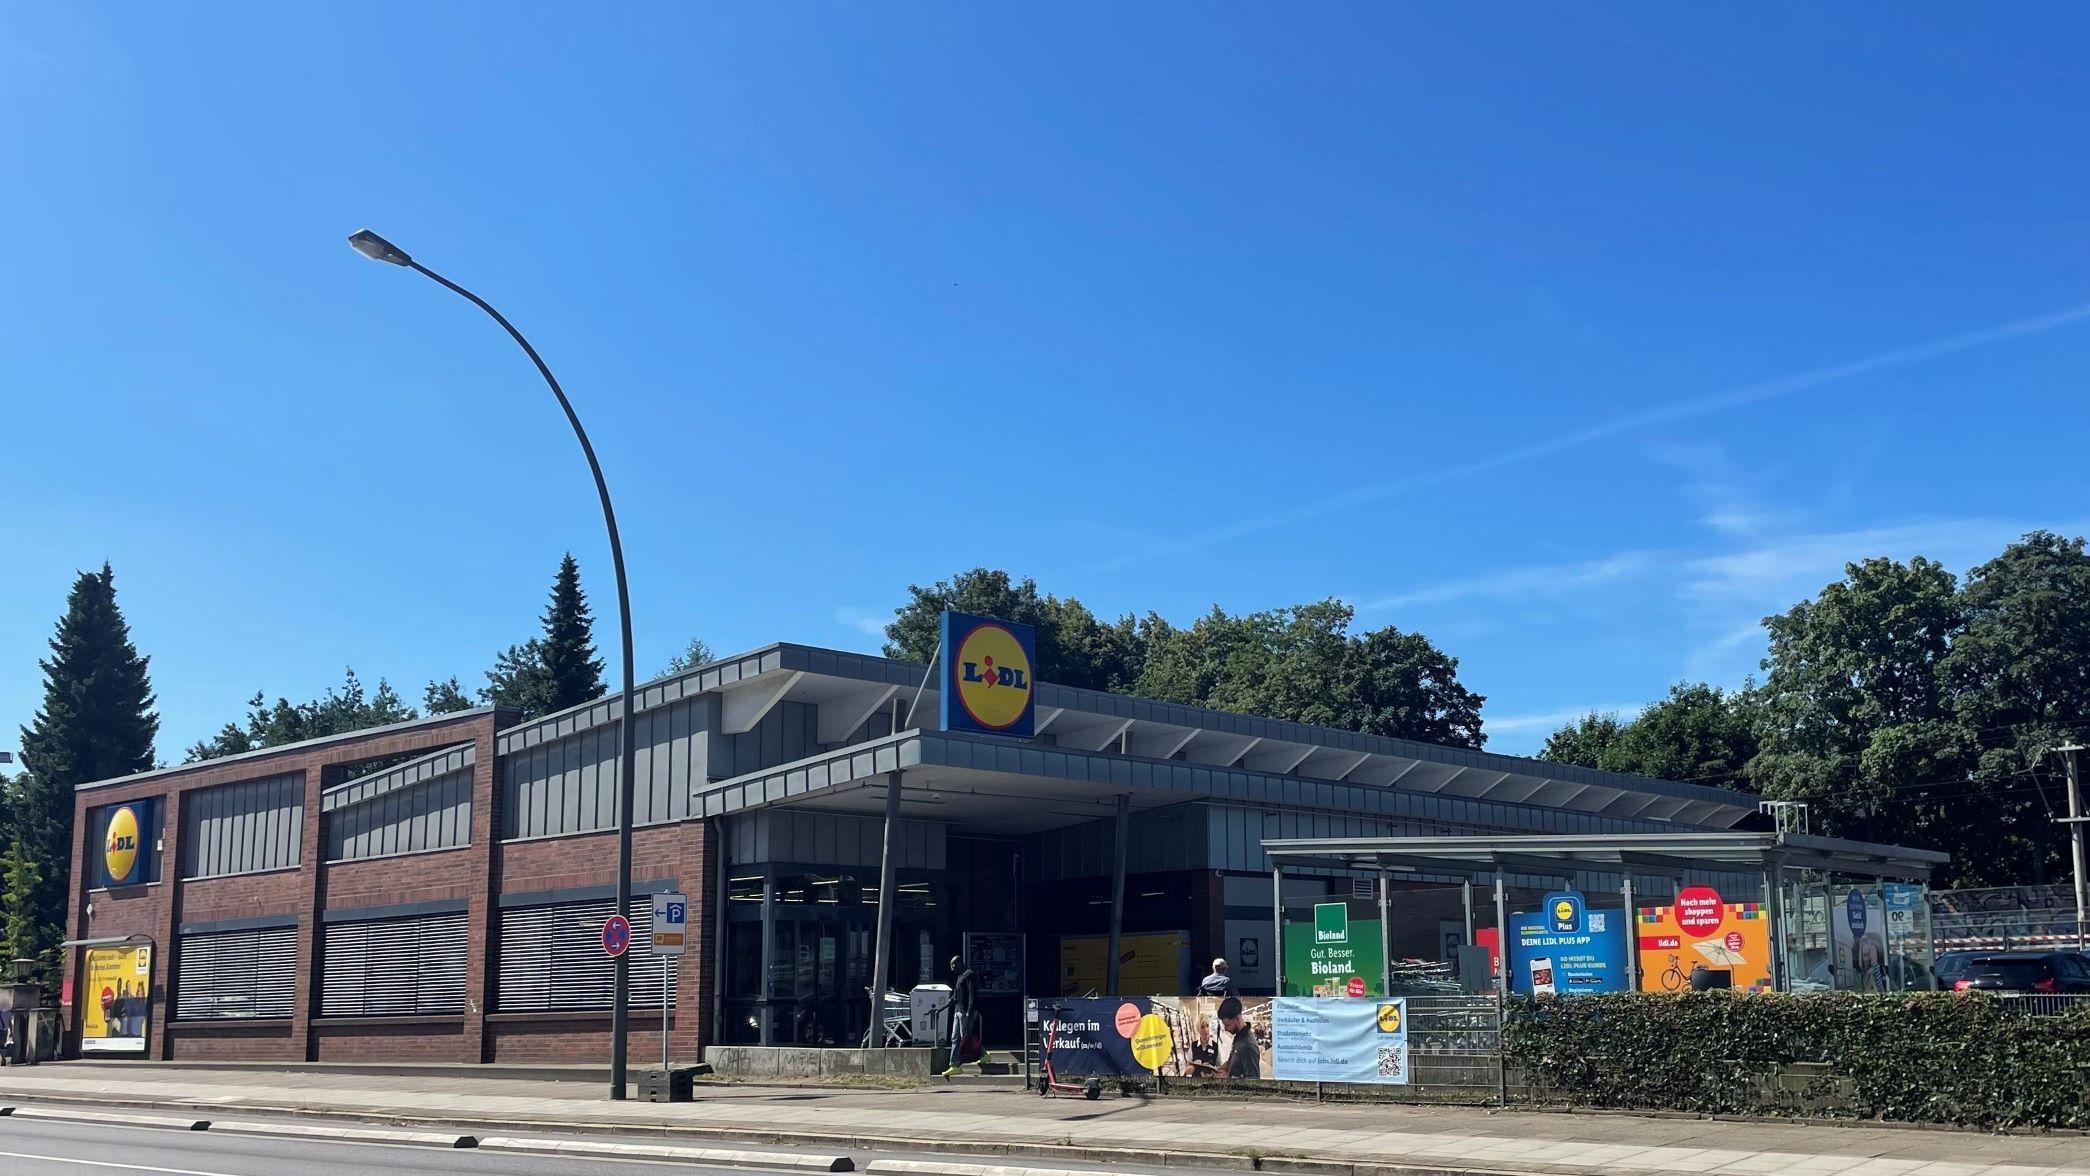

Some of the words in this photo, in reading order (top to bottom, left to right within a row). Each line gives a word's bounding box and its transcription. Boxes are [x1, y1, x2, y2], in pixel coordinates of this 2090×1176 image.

[1680, 898, 1698, 906] Noch
[1699, 898, 1716, 906] mehr
[1685, 908, 1714, 917] shoppen
[1557, 922, 1573, 930] Plus
[1681, 917, 1695, 925] und
[1696, 918, 1720, 926] sparen
[1318, 929, 1345, 940] Bioland
[1520, 938, 1541, 946] DEINE
[1542, 937, 1558, 945] LIDL
[1558, 937, 1576, 945] PLUS
[1576, 936, 1591, 944] APP
[1658, 939, 1679, 947] lidl.de
[1310, 948, 1326, 959] Gut.
[1328, 948, 1355, 958] Besser.
[1311, 960, 1355, 974] Bioland.
[1087, 1019, 1100, 1031] im
